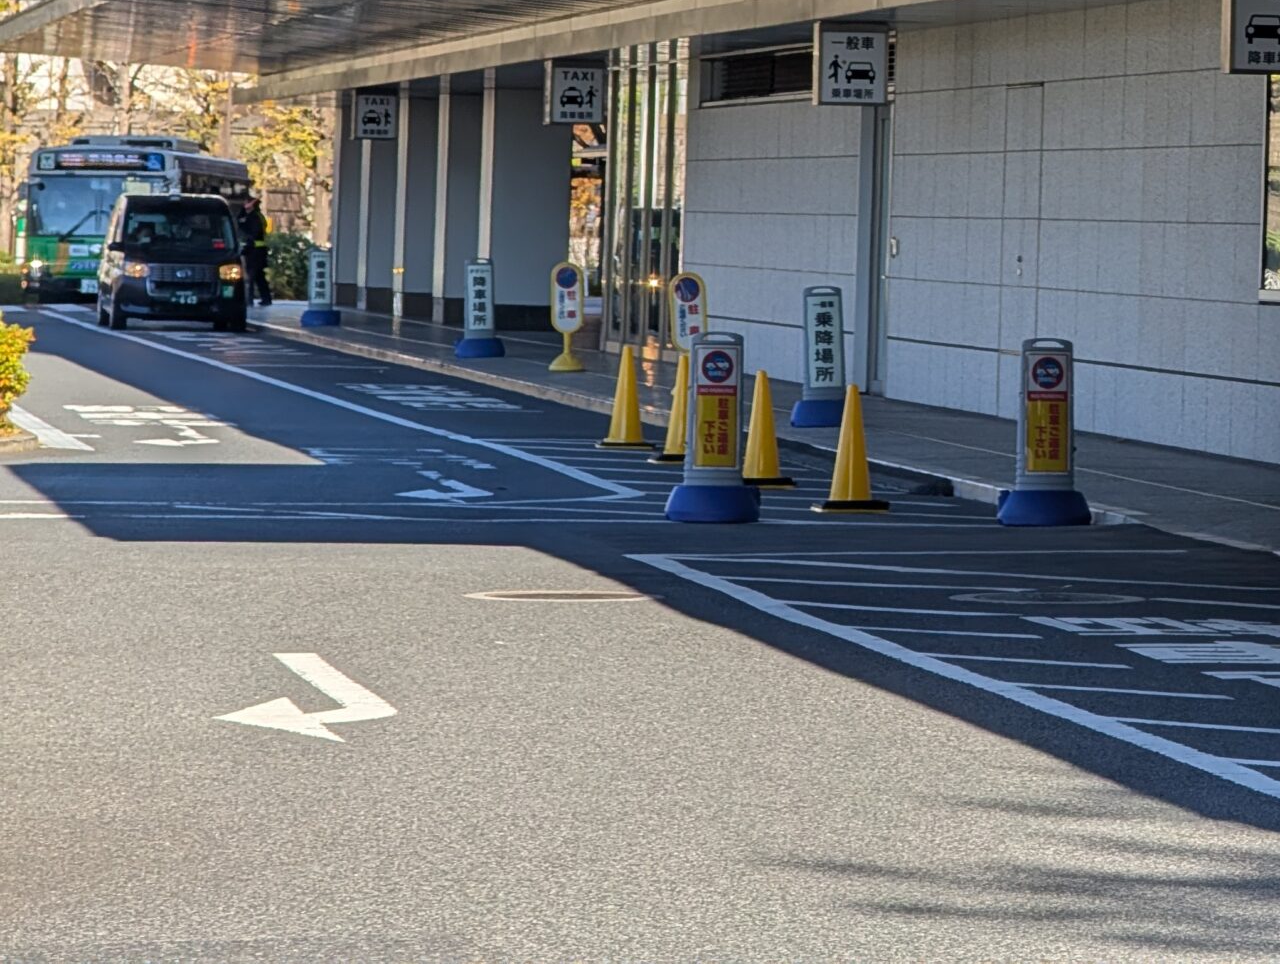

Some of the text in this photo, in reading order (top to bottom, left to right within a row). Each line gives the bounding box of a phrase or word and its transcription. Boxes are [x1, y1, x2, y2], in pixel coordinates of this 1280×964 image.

[831, 36, 874, 50] 一般車
[562, 70, 594, 81] TAXI
[364, 97, 390, 105] TAXI
[814, 311, 834, 382] 乗降場所
